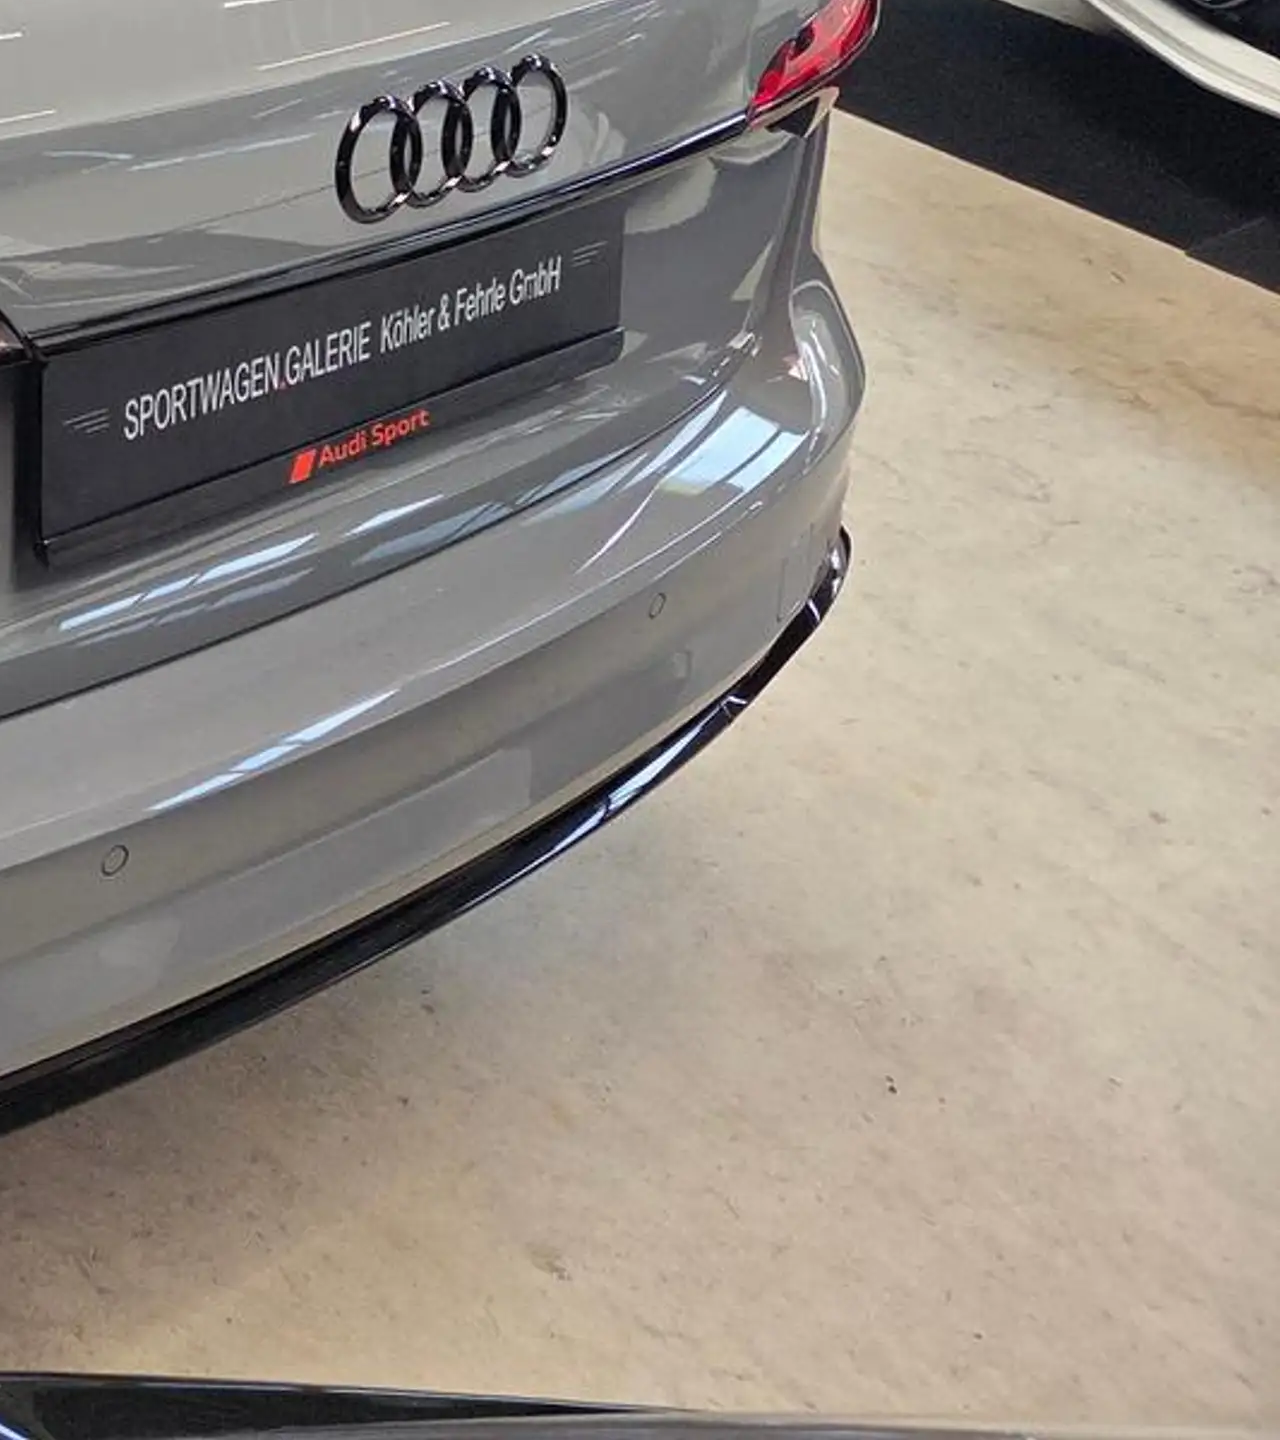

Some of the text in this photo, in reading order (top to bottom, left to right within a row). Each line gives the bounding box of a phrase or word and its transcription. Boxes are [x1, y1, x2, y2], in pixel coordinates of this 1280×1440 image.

[380, 304, 436, 354] Köhler
[437, 293, 451, 331] &
[454, 277, 506, 326] Fehrle
[509, 255, 562, 305] GmbH
[319, 408, 430, 468] Audi Sport
